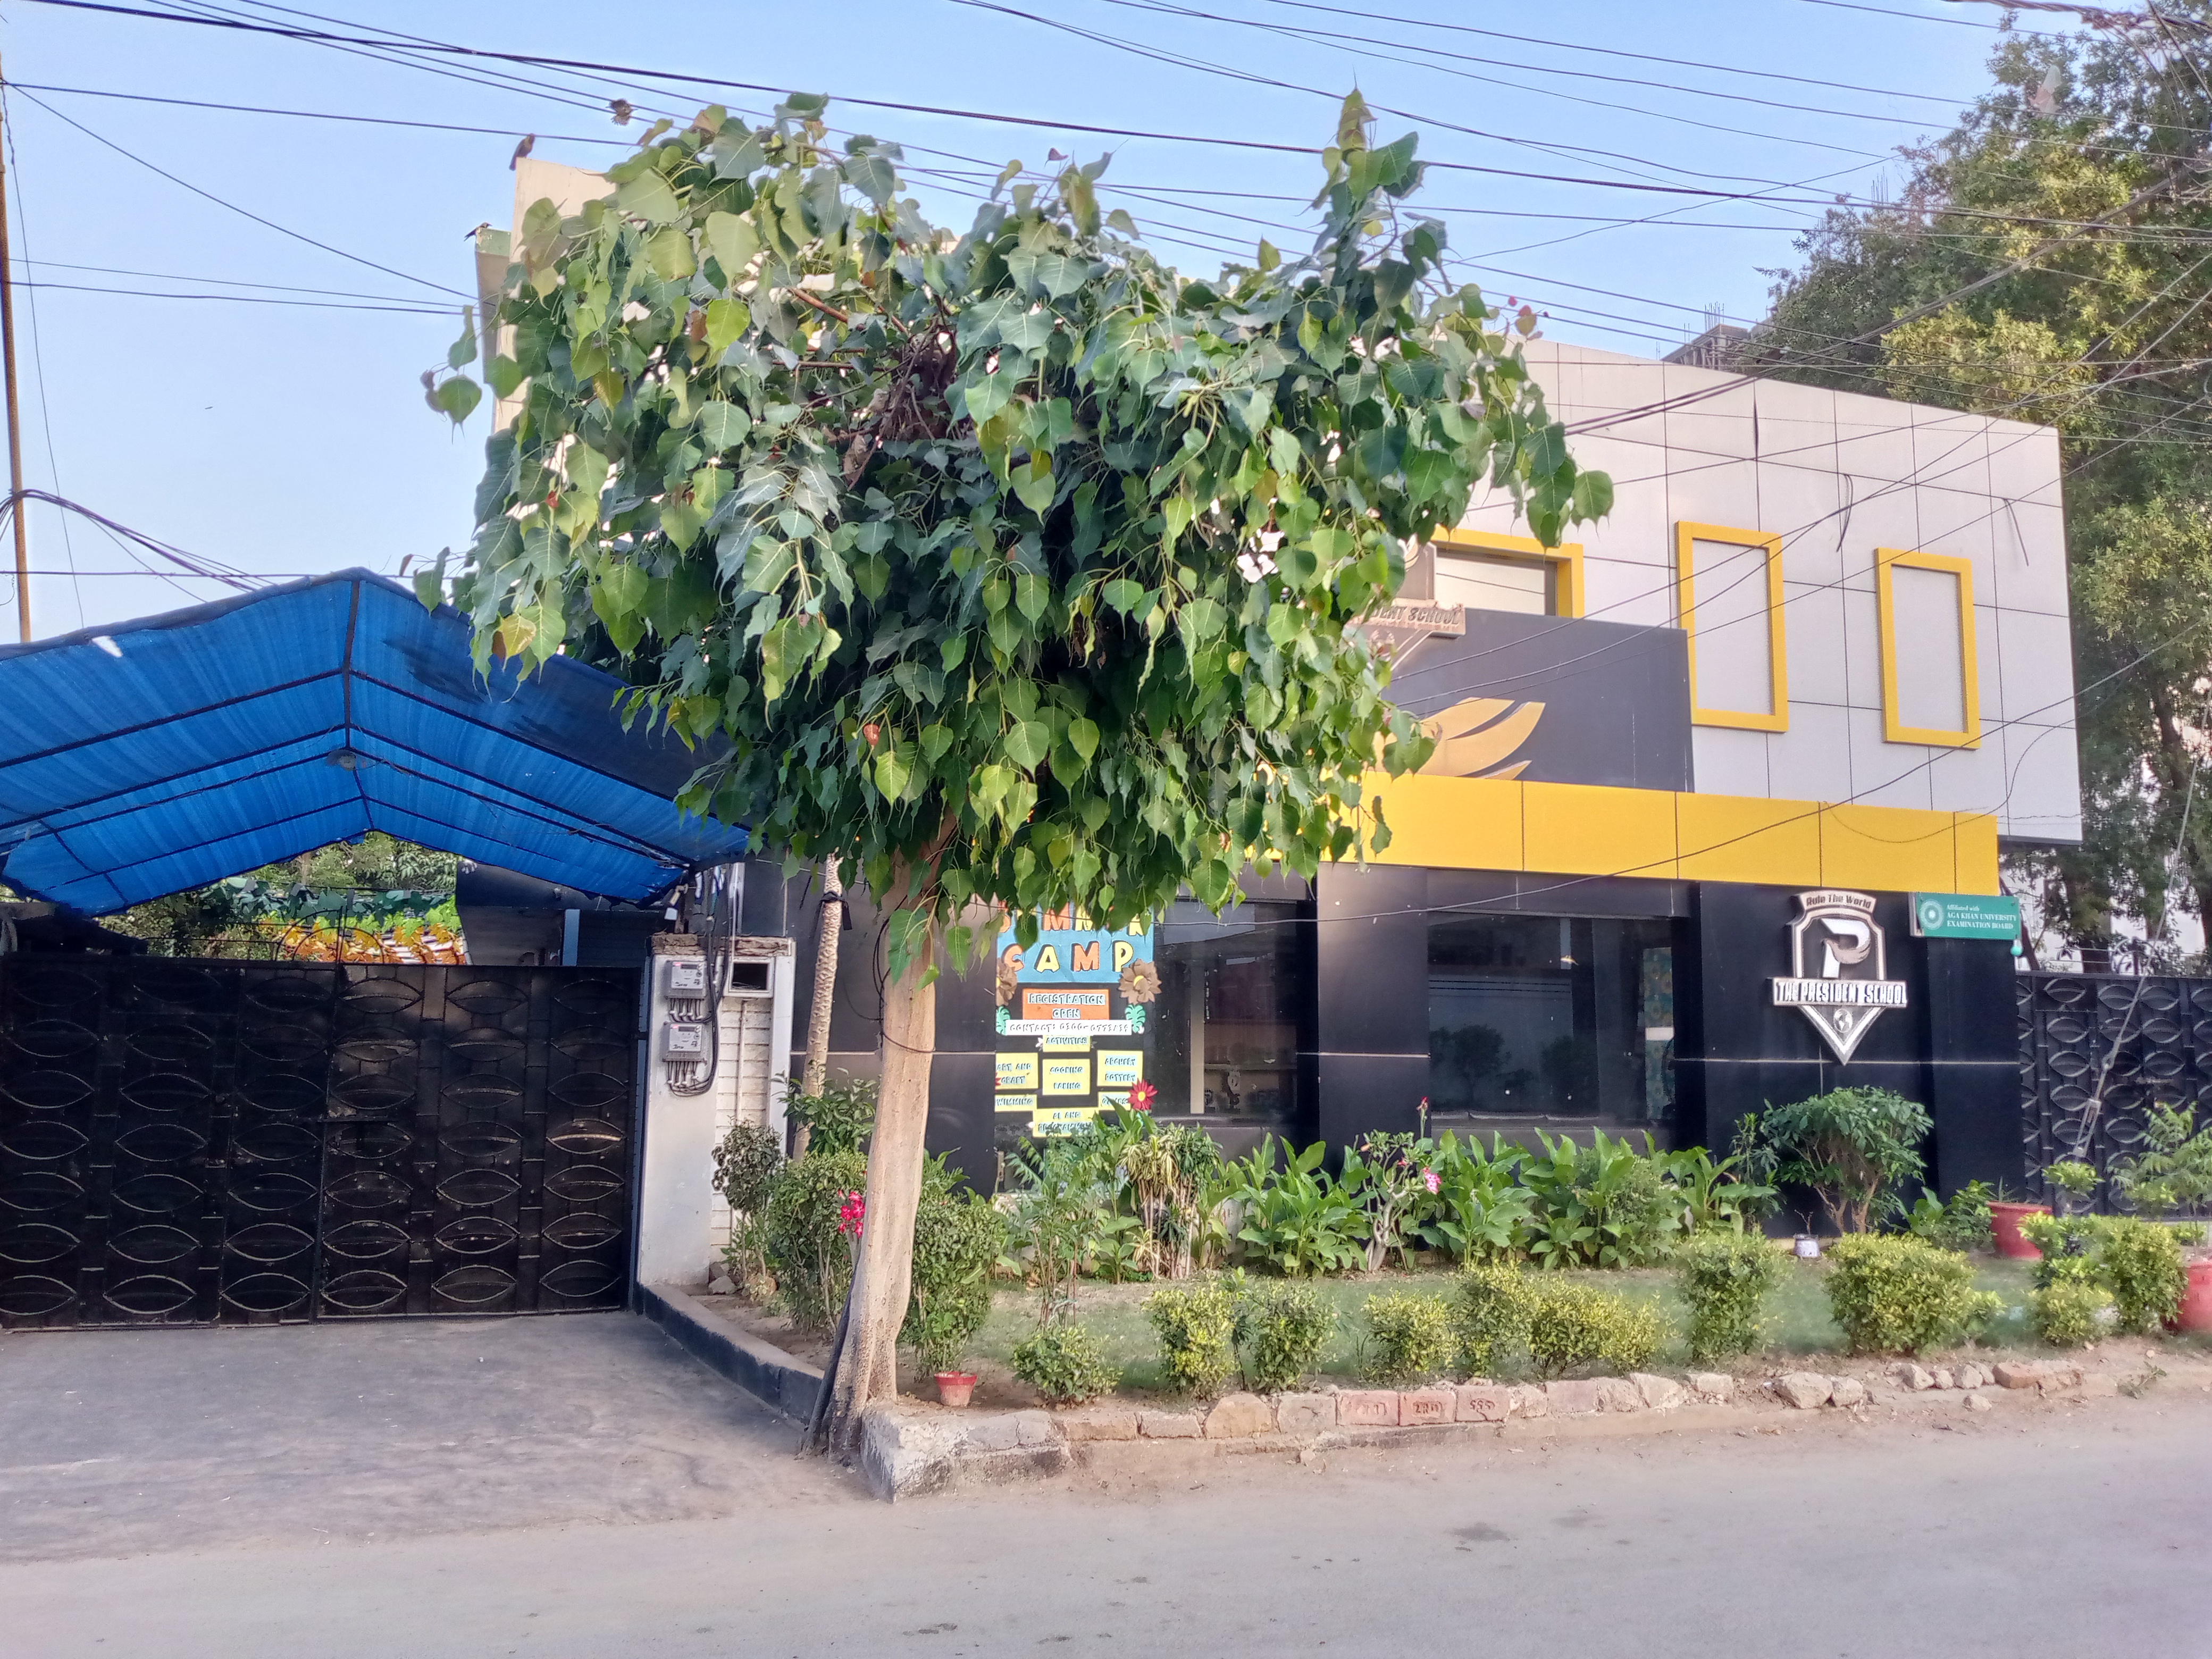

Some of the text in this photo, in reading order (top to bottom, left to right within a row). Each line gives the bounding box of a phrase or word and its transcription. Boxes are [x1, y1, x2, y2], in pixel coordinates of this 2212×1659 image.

[1409, 607, 1460, 625] SCHOOL
[1828, 894, 1843, 903] The
[1846, 894, 1872, 909] World
[1002, 940, 1134, 973] CAMP
[1029, 993, 1104, 1004] REGISTRATION
[1777, 982, 1907, 1003] THE PRESIDENT SCHOOL
[1052, 1009, 1080, 1018] OPEN
[1105, 1057, 1136, 1066] ARCHERY
[1105, 1073, 1136, 1082] POTTERY
